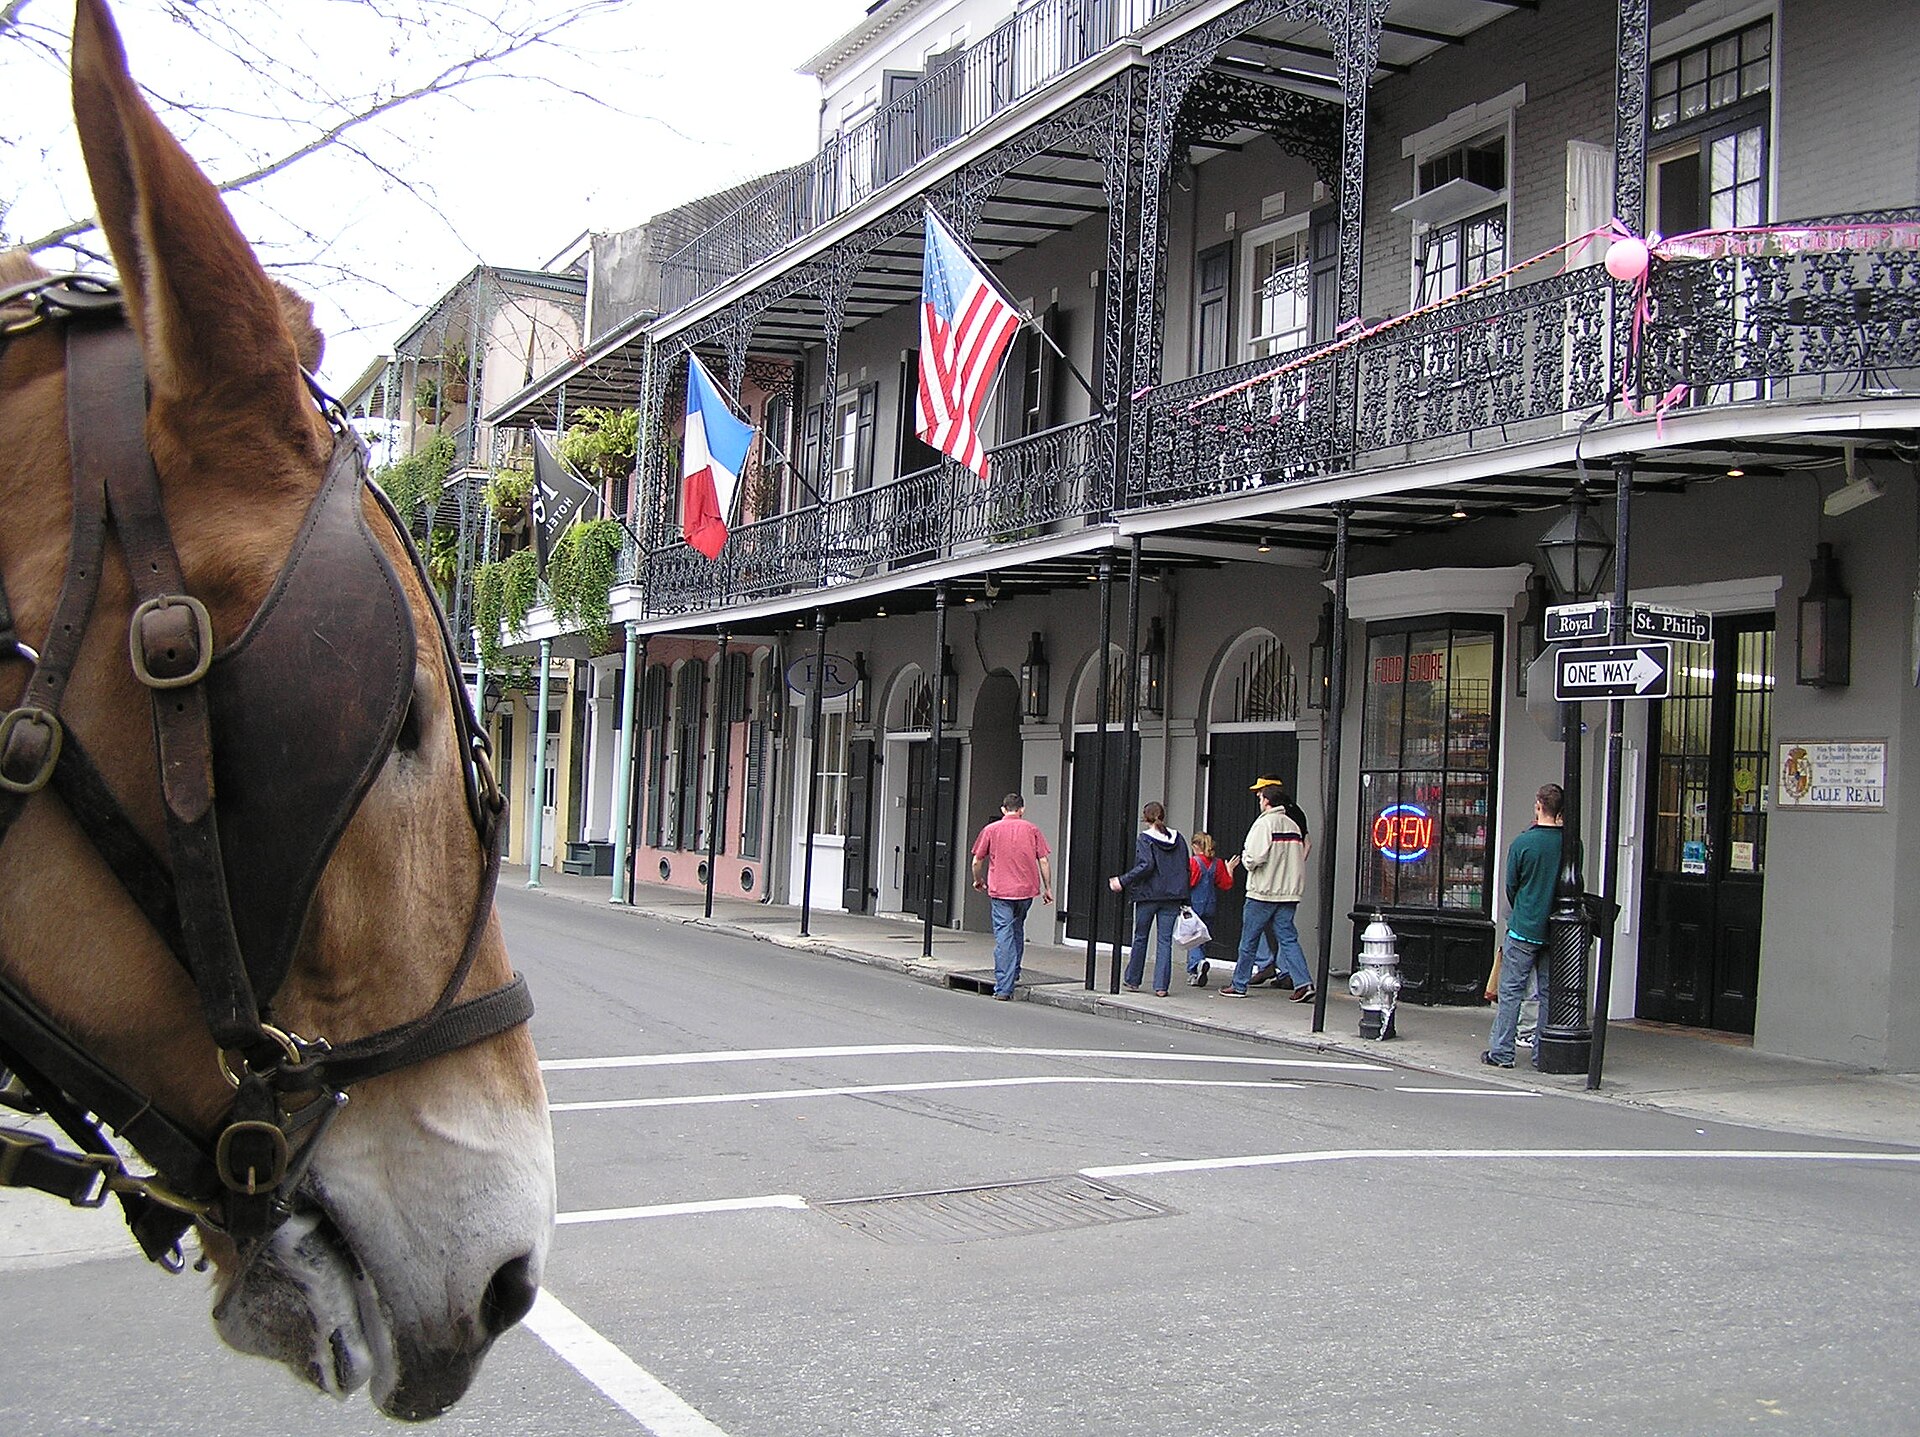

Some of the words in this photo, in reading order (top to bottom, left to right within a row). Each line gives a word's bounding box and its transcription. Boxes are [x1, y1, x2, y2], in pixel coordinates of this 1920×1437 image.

[1559, 614, 1593, 636] Royal
[1636, 613, 1656, 631] St.
[1662, 616, 1706, 641] Philip
[1374, 655, 1403, 683] FOOD
[1409, 653, 1444, 681] STORE
[1567, 664, 1597, 684] ONE
[1602, 662, 1634, 682] WAY
[1811, 786, 1841, 802] CALLE
[1846, 786, 1881, 803] REAL
[1373, 816, 1433, 849] OPEN
